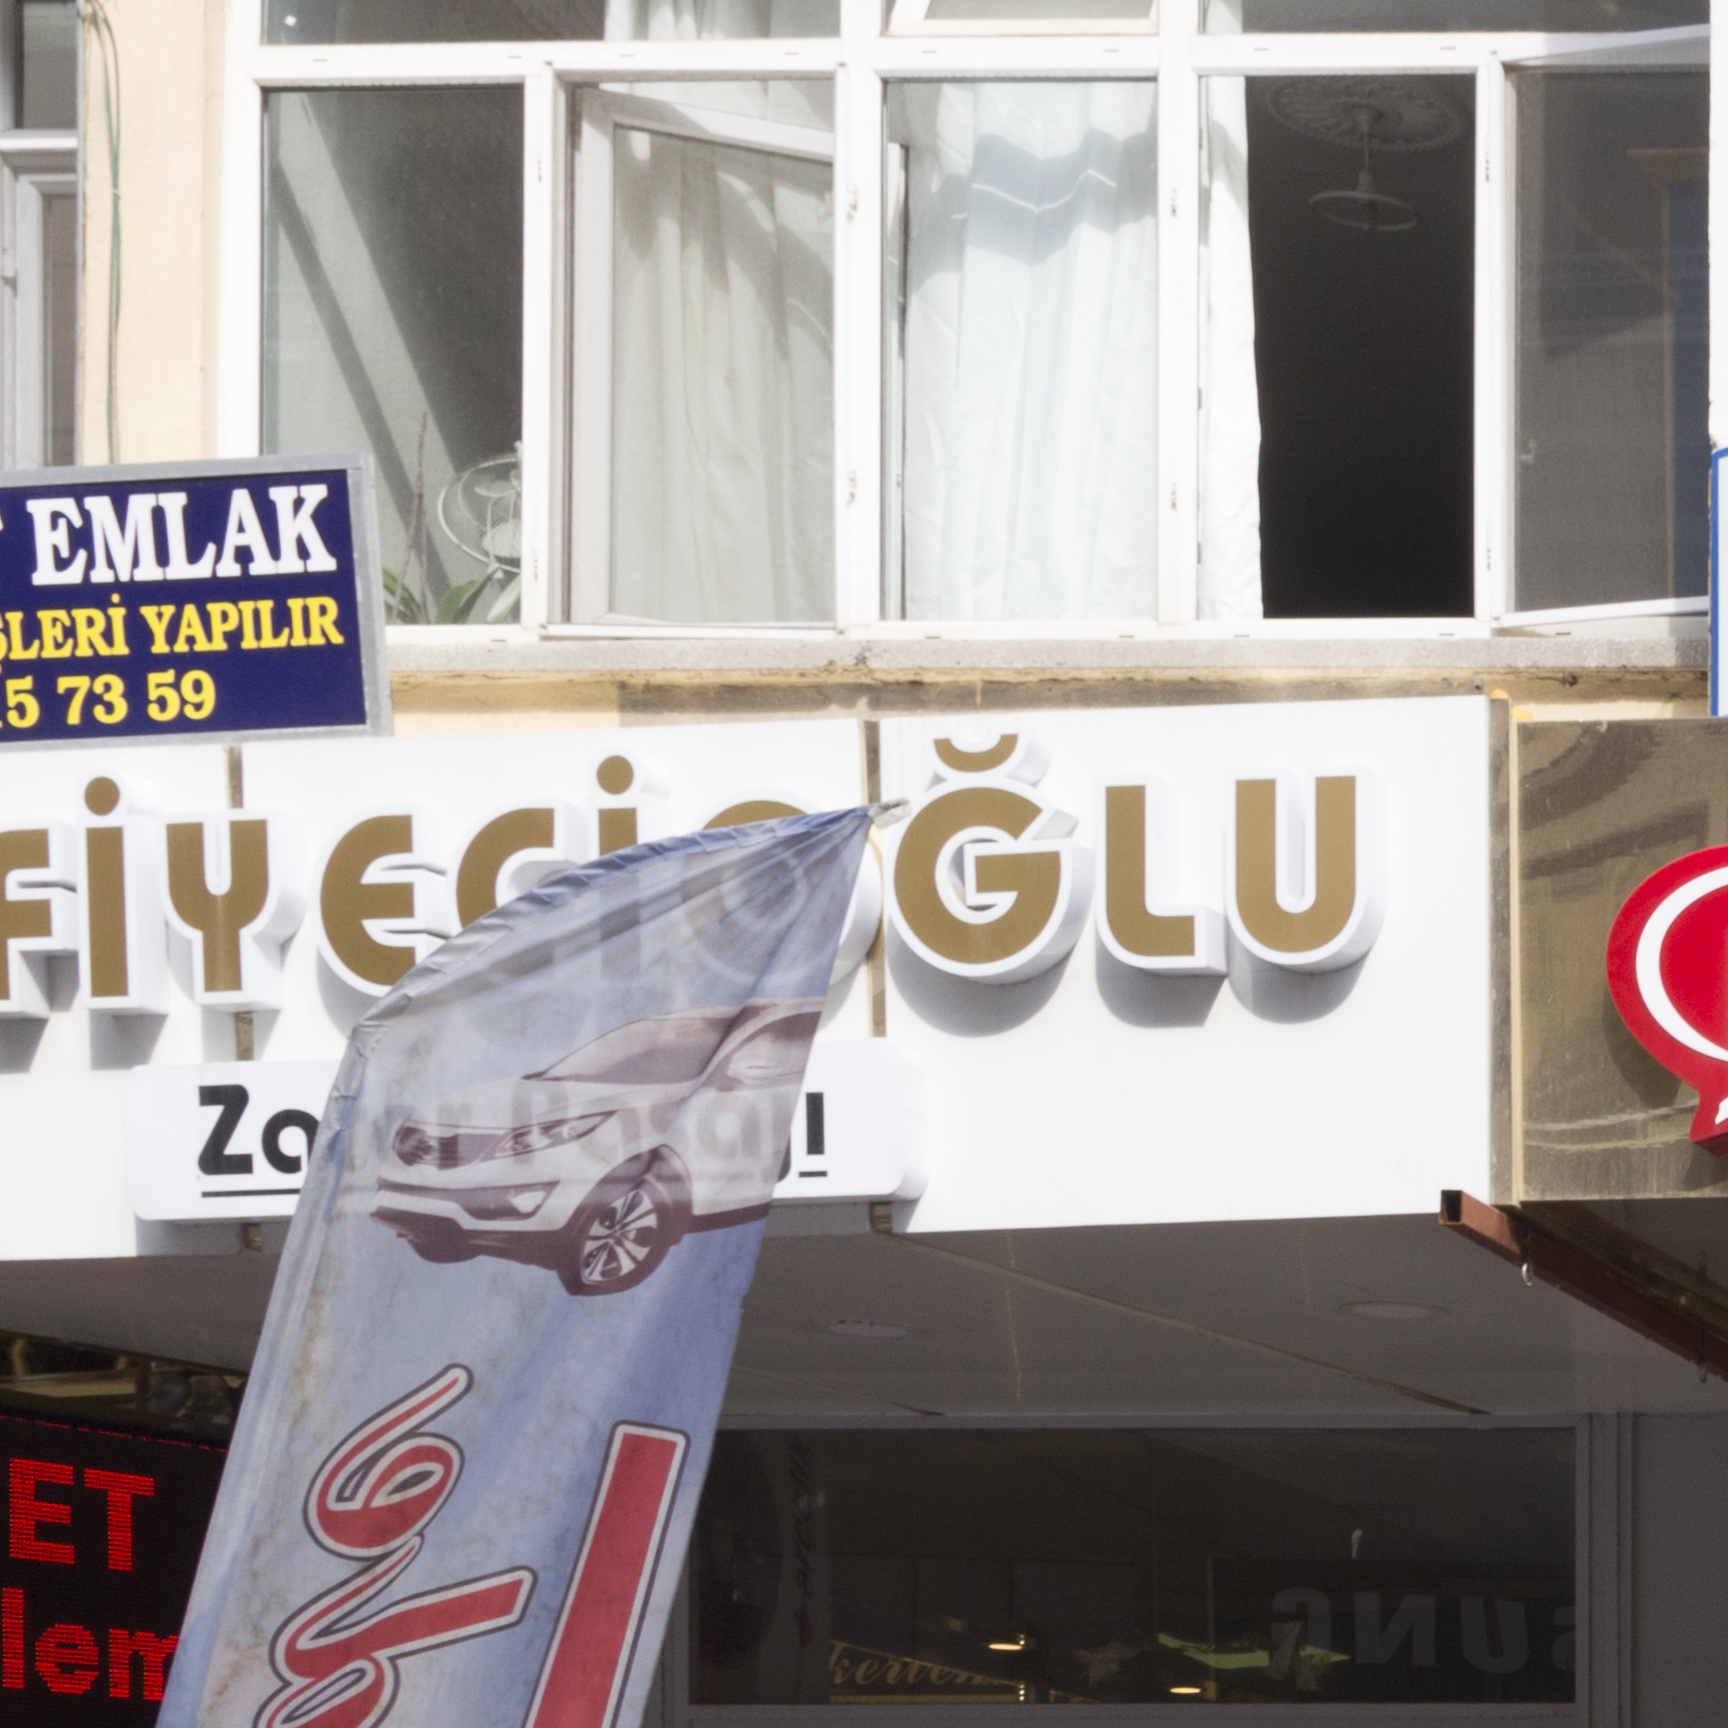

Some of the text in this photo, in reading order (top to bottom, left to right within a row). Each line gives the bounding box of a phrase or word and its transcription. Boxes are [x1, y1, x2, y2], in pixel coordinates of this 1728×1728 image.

[27, 483, 338, 586] EMLAK
[0, 593, 345, 664] LERİ YAPILIR
[0, 669, 217, 730] 5 73 59
[8, 1457, 155, 1572] ET
